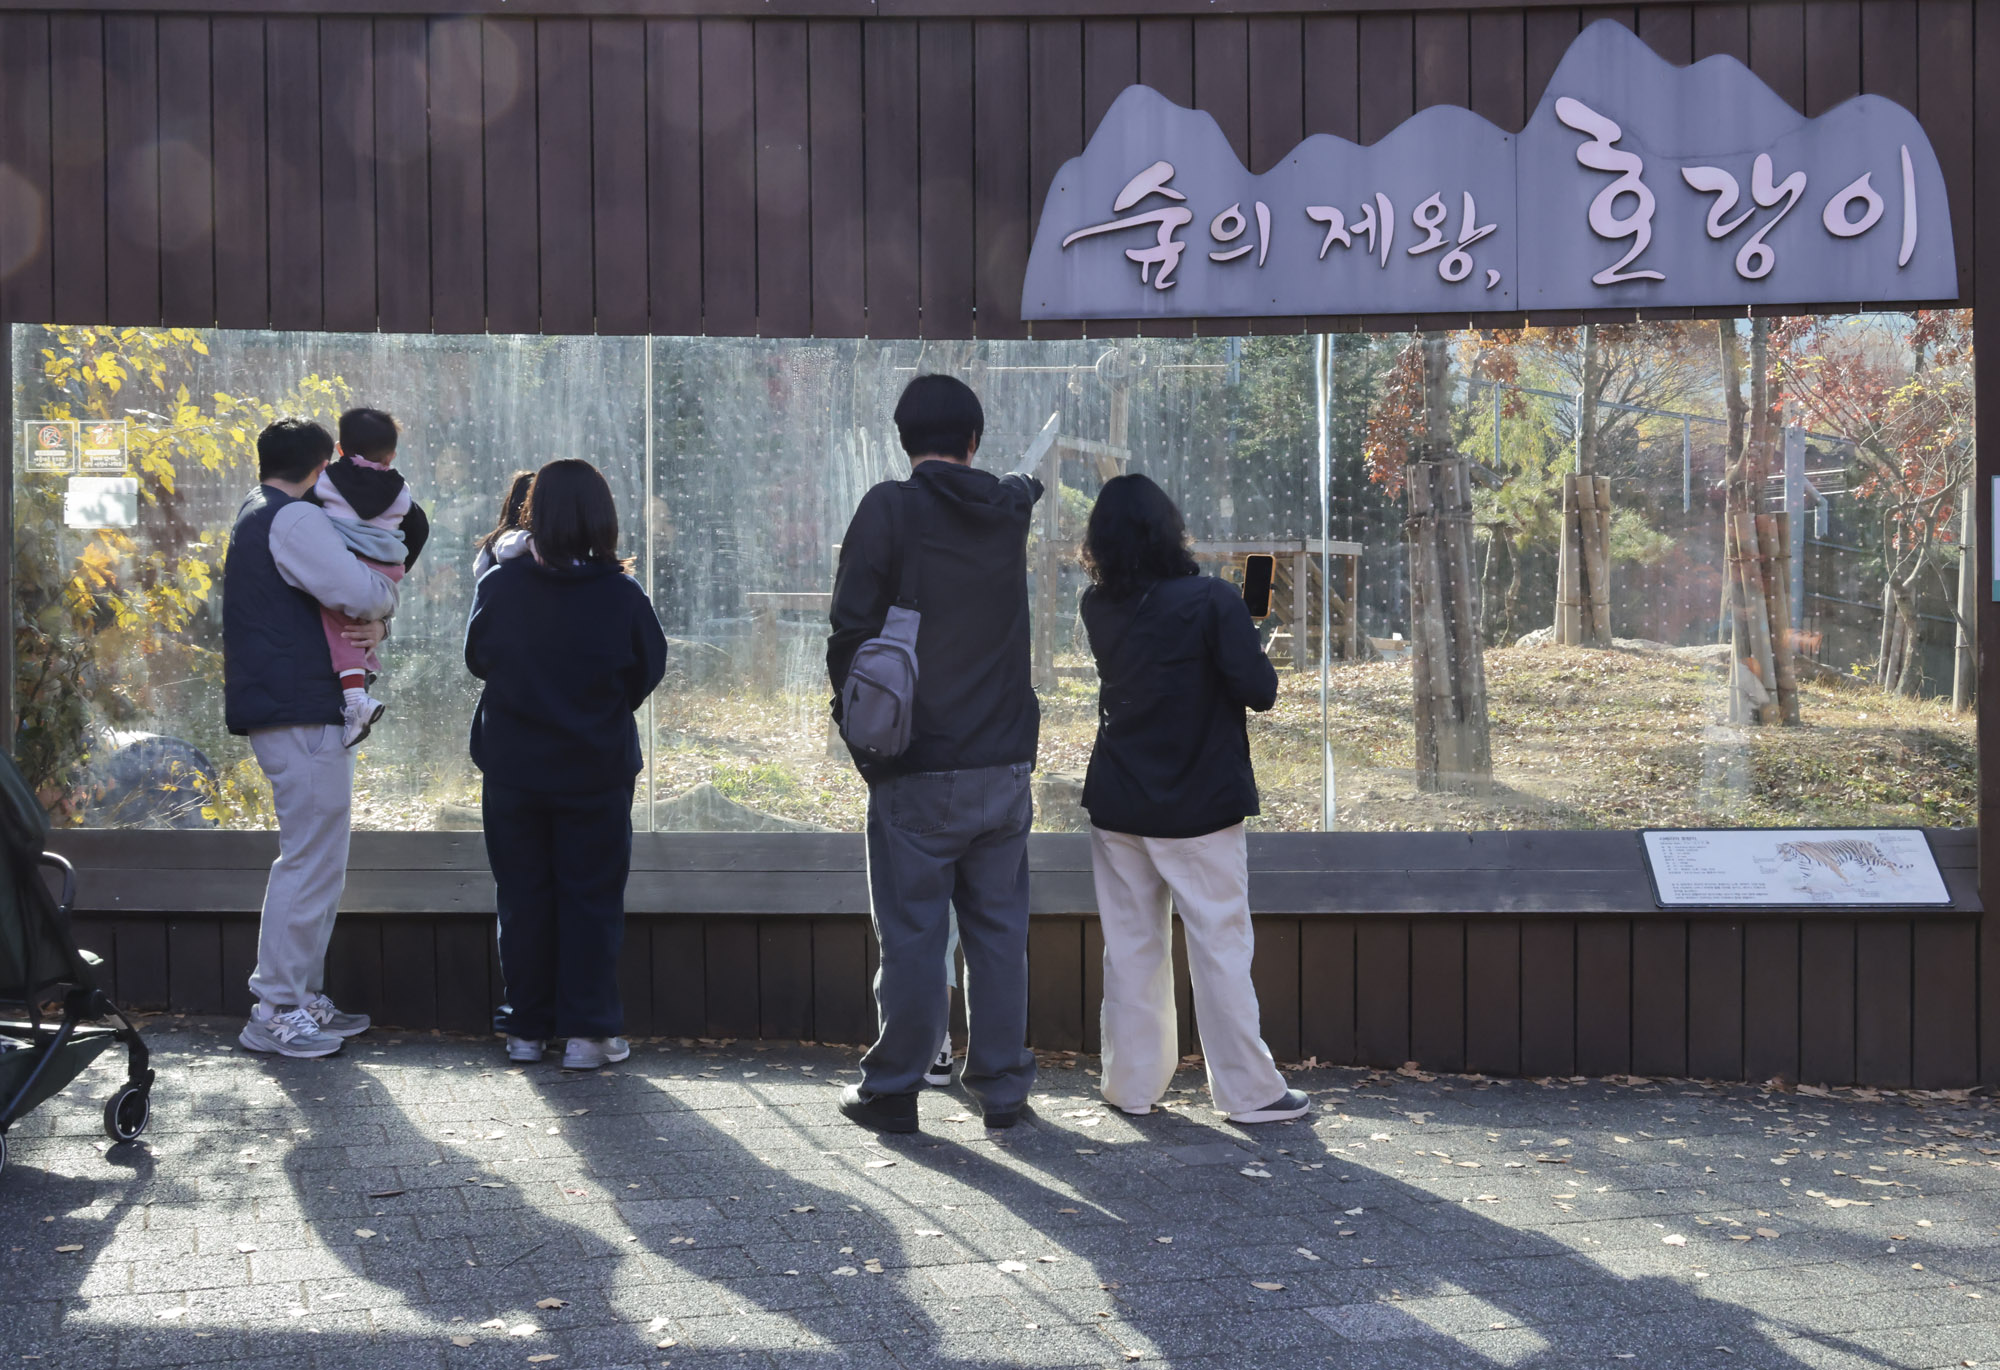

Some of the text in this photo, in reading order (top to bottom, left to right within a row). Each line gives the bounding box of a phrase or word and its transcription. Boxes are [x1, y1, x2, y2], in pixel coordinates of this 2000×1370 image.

[1062, 97, 1917, 290] 숲의 제왕, 호랑이
[266, 1024, 298, 1043] N
